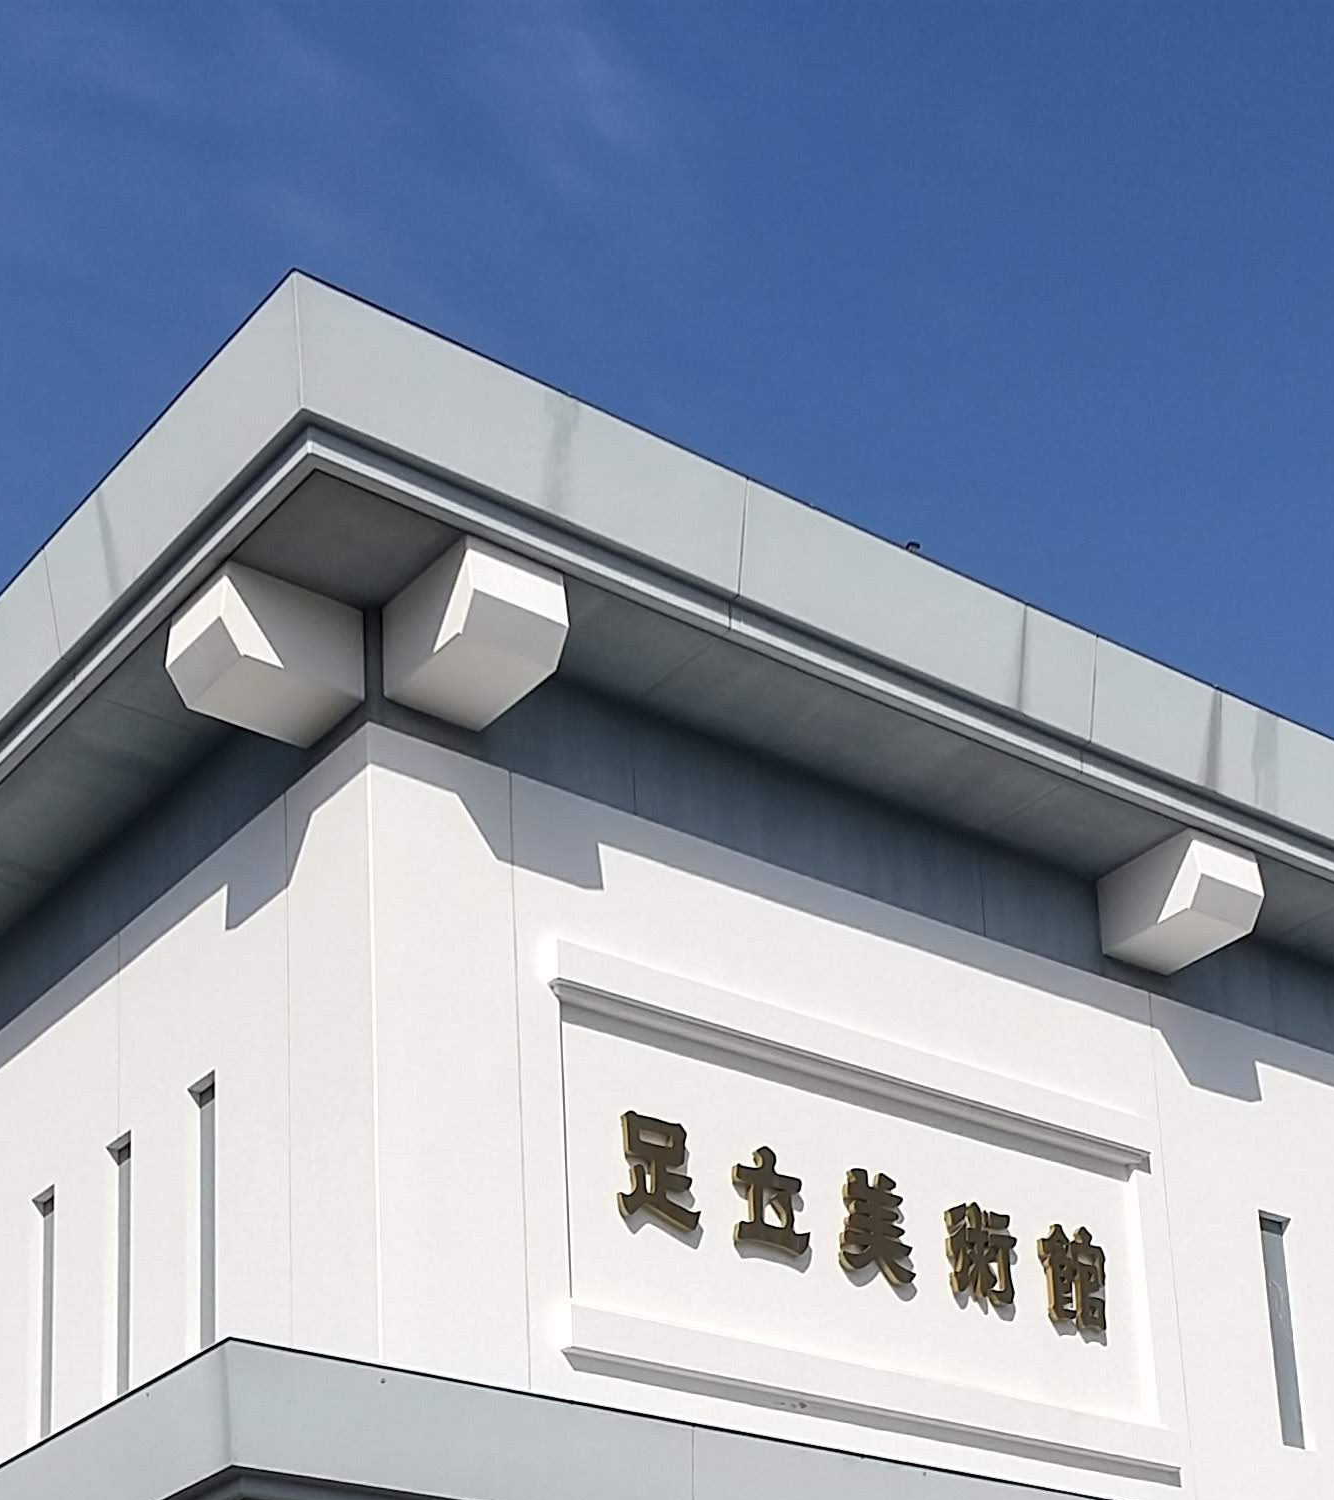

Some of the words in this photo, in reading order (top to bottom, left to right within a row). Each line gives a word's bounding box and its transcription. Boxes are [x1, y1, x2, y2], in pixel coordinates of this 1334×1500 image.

[617, 1110, 1107, 1334] 足立美術館
